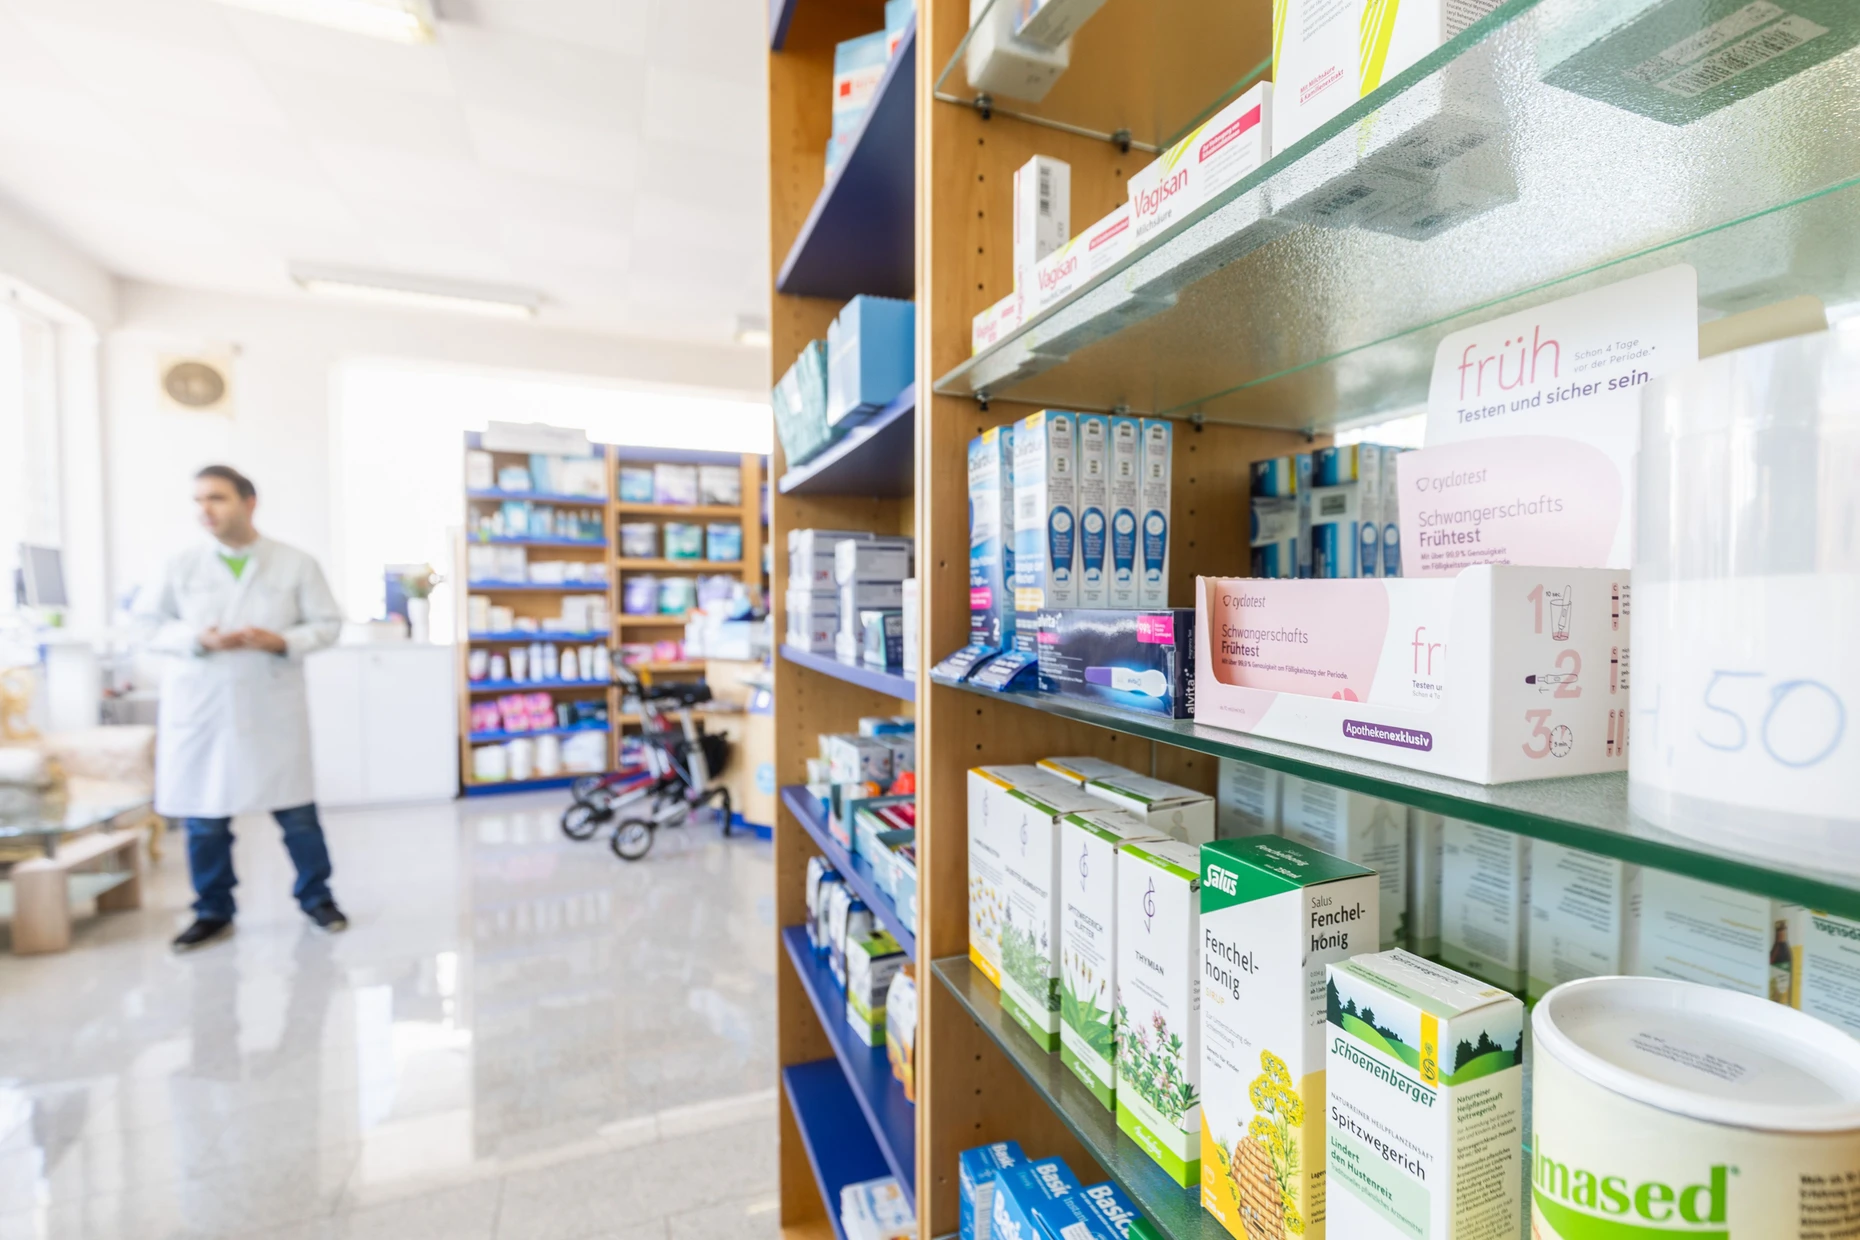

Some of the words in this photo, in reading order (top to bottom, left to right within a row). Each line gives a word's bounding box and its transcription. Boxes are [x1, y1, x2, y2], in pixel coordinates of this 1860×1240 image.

[1134, 168, 1188, 219] Vagisan
[1136, 208, 1172, 237] Milchsäure
[1038, 255, 1078, 292] Vagisan
[1458, 325, 1561, 400] früh
[1574, 347, 1603, 361] Schon
[1605, 344, 1612, 352] 4
[1616, 339, 1640, 351] Tage
[1574, 362, 1588, 373] vor
[1591, 358, 1607, 369] der
[1457, 404, 1506, 424] Testen
[1511, 391, 1541, 412] und
[1546, 380, 1602, 404] sicher
[1608, 369, 1654, 391] sein.
[1432, 468, 1487, 492] cyclotest
[1419, 495, 1563, 527] Schwangerschafts
[1420, 528, 1481, 547] Frühtest
[1431, 551, 1444, 559] über
[1467, 547, 1507, 556] Genauigkeit
[1232, 594, 1266, 610] cyclotest
[1527, 584, 1544, 634] 1
[1222, 624, 1308, 644] Schwangerschafts
[1222, 641, 1260, 657] Frühtest
[1412, 626, 1446, 675] fr
[1252, 661, 1277, 671] Genauigkeit
[1285, 665, 1317, 676] Fälligkeitstag
[1317, 669, 1326, 677] der
[1327, 670, 1349, 679] Periode.
[1553, 649, 1583, 698] 2
[1185, 677, 1195, 714] alvita
[1412, 680, 1434, 690] Testen
[1345, 722, 1430, 747] Apothekenexklusiv
[1521, 709, 1552, 759] 3
[1203, 864, 1239, 896] Salus
[1311, 896, 1333, 909] Salus
[1311, 902, 1366, 929] Fenchel-
[1205, 928, 1260, 975] Fenchel-
[1311, 931, 1349, 952] honig
[1135, 950, 1164, 976] THYMIAN
[1205, 954, 1240, 1000] honig
[1389, 953, 1460, 986] Spitzwegerich
[1205, 987, 1225, 1004] SIRUP
[1226, 1059, 1240, 1073] Kinder
[1331, 1037, 1437, 1108] Schoenenberger
[1457, 1089, 1491, 1104] Naturreiner
[1457, 1092, 1503, 1113] Heilpflanzensaft
[1331, 1092, 1370, 1122] NATURREINER
[1371, 1119, 1434, 1162] HEILPFLANZENSAFT
[1457, 1103, 1497, 1124] Spitzwegerich
[1331, 1106, 1426, 1181] Spitzwegerich
[1331, 1136, 1360, 1164] Lindert
[1331, 1150, 1346, 1172] den
[1347, 1160, 1393, 1201] Hustenreiz
[1532, 1134, 1728, 1224] lmased
[1063, 1196, 1089, 1223] Instant
[1331, 1163, 1362, 1193] Traditionelles
[1361, 1182, 1390, 1212] pflanzliches
[1390, 1203, 1424, 1236] Arzneimittel
